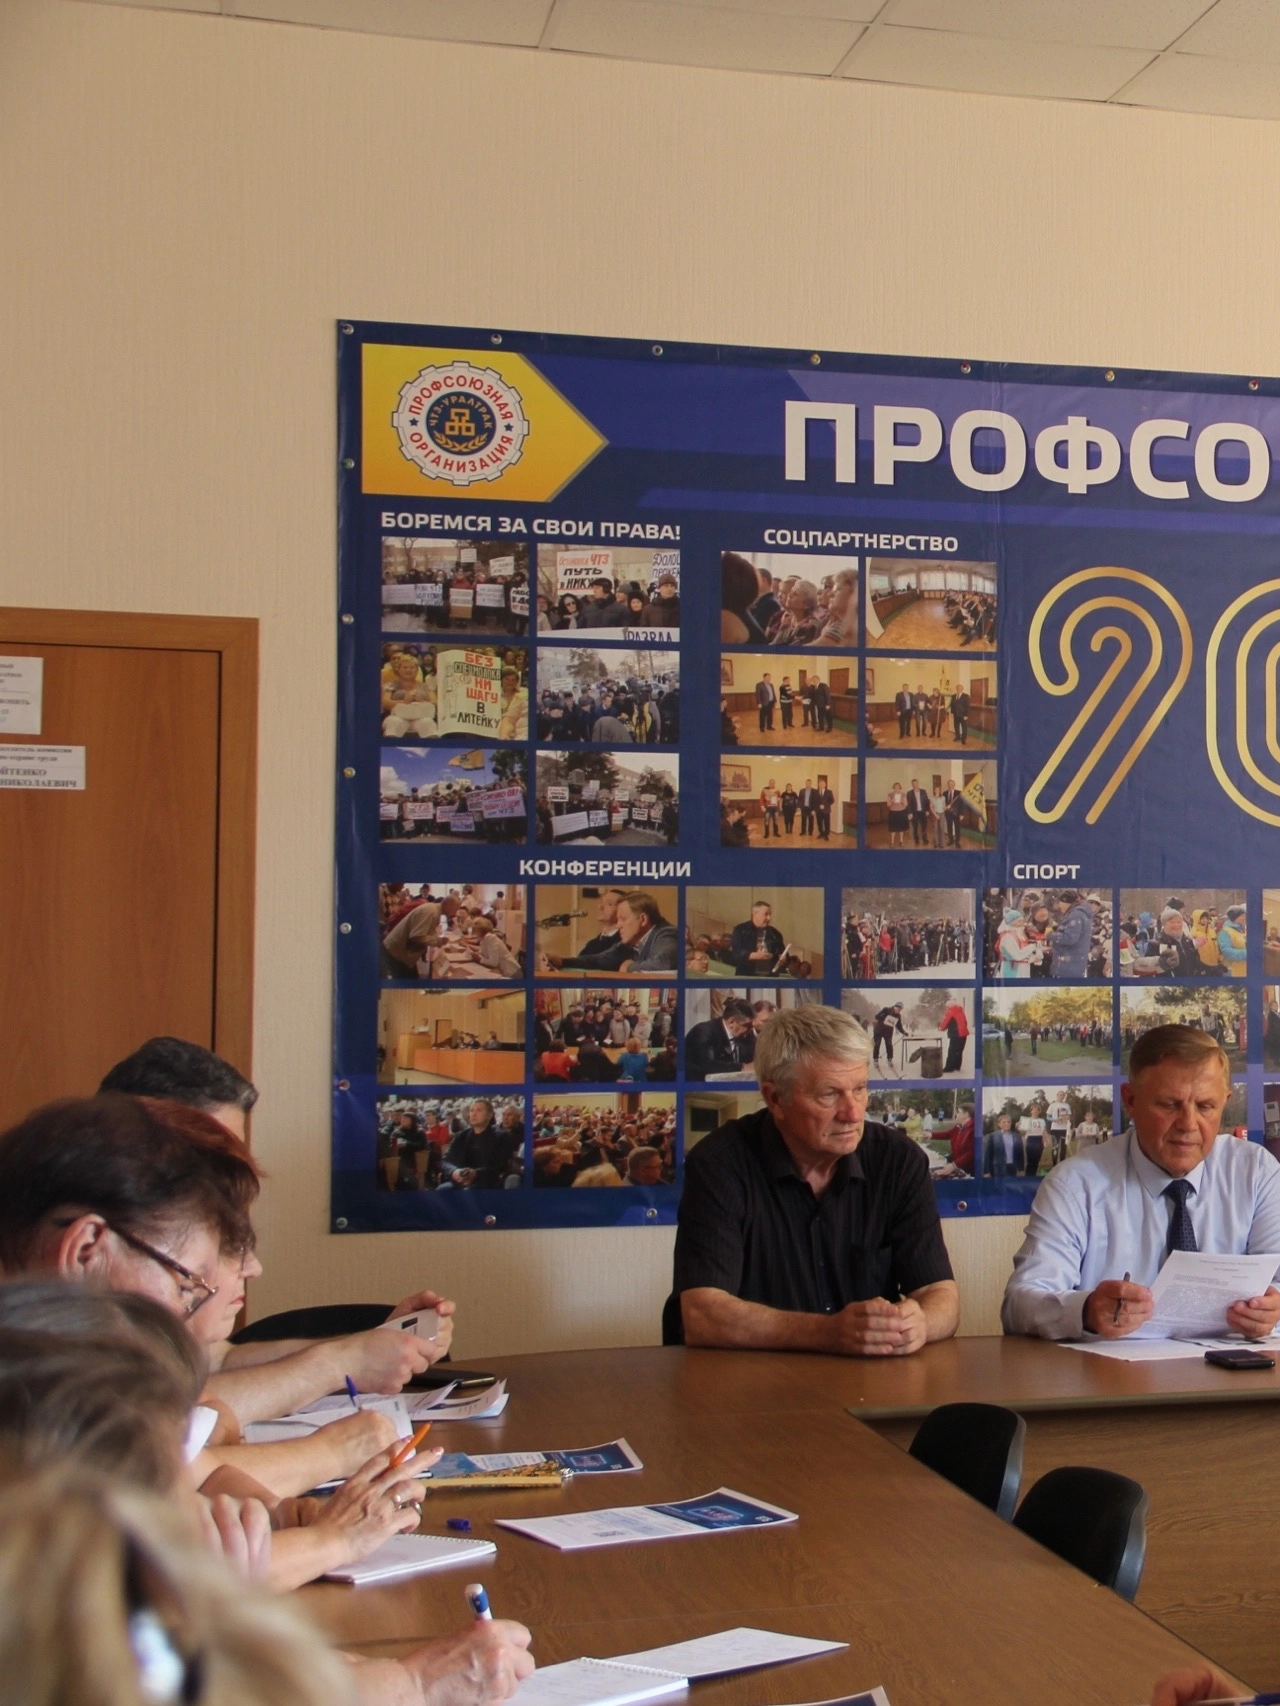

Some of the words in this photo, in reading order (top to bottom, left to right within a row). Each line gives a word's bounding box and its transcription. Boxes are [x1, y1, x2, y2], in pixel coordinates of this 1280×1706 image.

[408, 375, 514, 420] ПРОФСОЮЗНАЯ
[409, 432, 514, 473] ОРГАНИЗАЦИЯ
[381, 511, 492, 532] БОРЕМСЯ
[498, 517, 528, 533] ЗА
[532, 518, 594, 537] СВОИ
[600, 521, 681, 540] ПРАВА!
[763, 528, 959, 552] СОЦПАРТНЕРСТВО
[563, 567, 603, 576] ПУТЬ
[464, 652, 494, 668] БЕЗ
[474, 677, 492, 690] НИ
[466, 687, 499, 704] ШАГУ
[476, 702, 486, 714] В
[519, 859, 691, 880] КОНФЕРЕНЦИИ
[1013, 864, 1081, 880] СПОРТ
